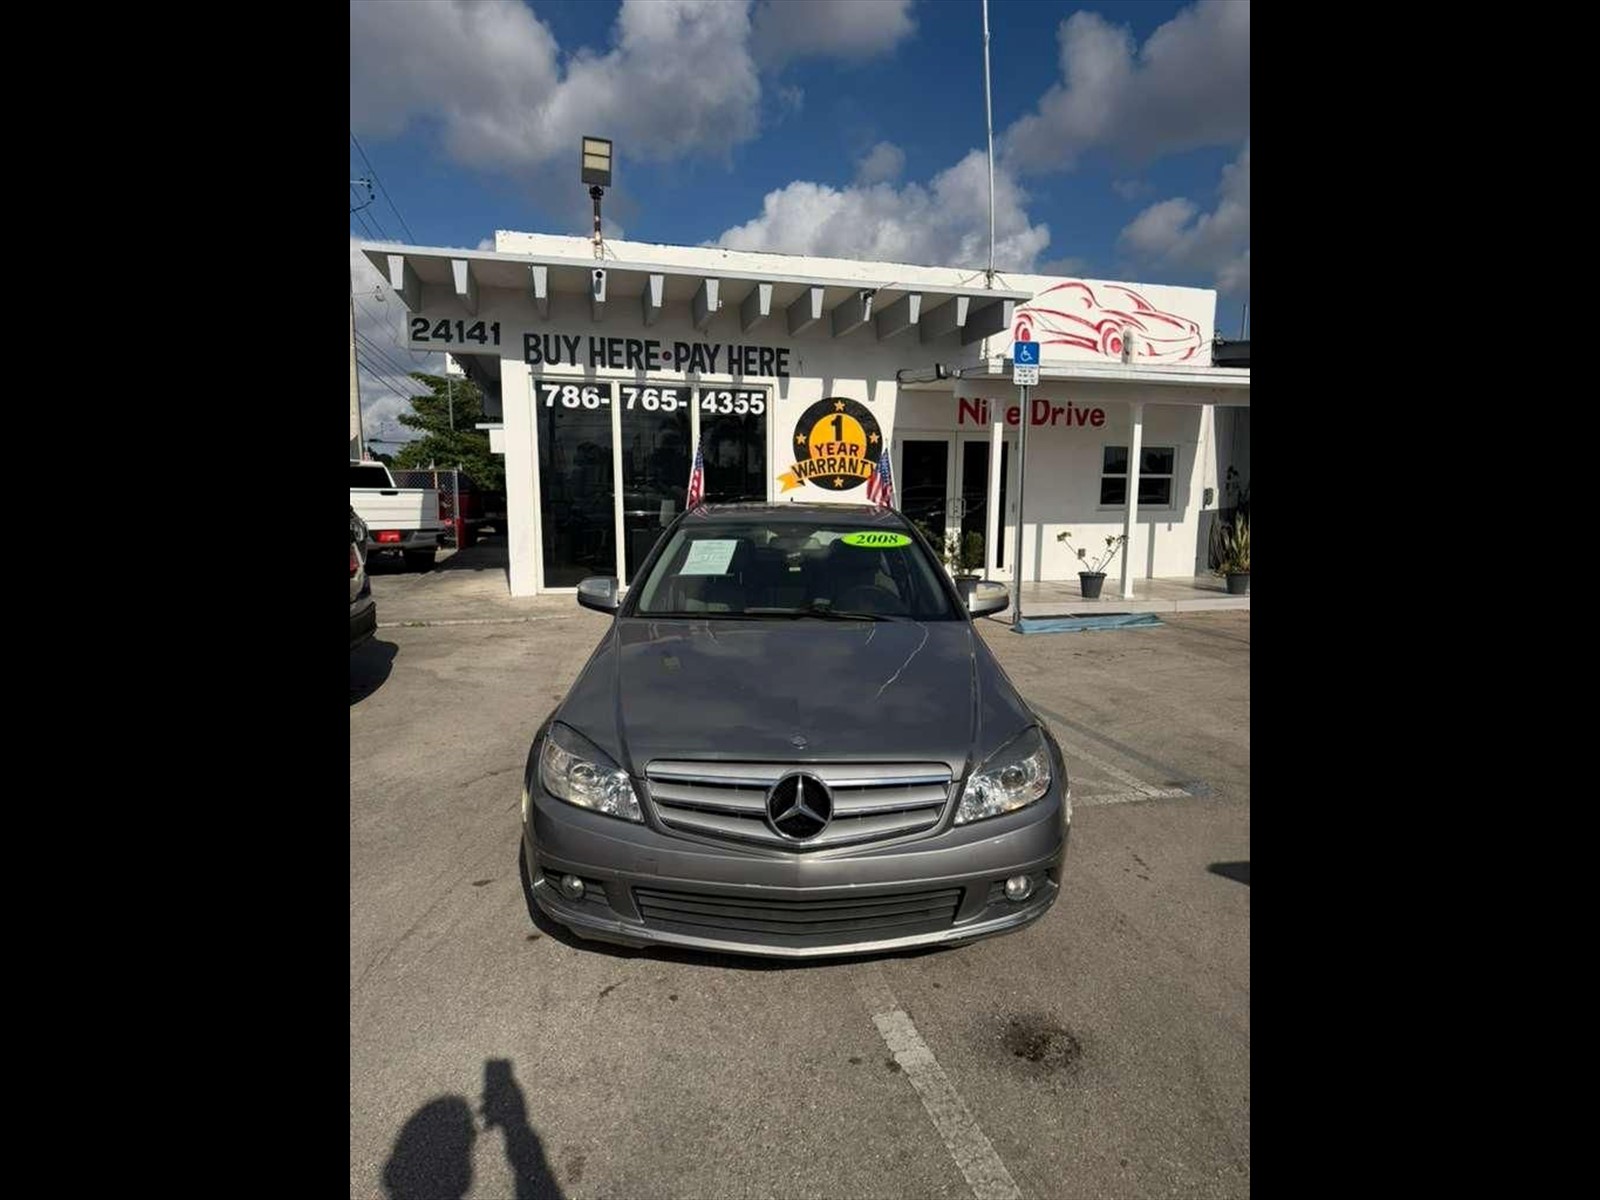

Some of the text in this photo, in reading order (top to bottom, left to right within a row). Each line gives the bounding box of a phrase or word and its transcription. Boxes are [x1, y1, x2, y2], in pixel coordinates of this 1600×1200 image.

[411, 317, 500, 345] 24141
[523, 333, 790, 377] BUY HERE PAY HERE
[541, 384, 765, 415] 786- 765- 4355
[958, 397, 1105, 427] Nie Drive
[831, 415, 843, 442] 1
[815, 443, 859, 457] YEAR
[856, 534, 898, 544] 2008
